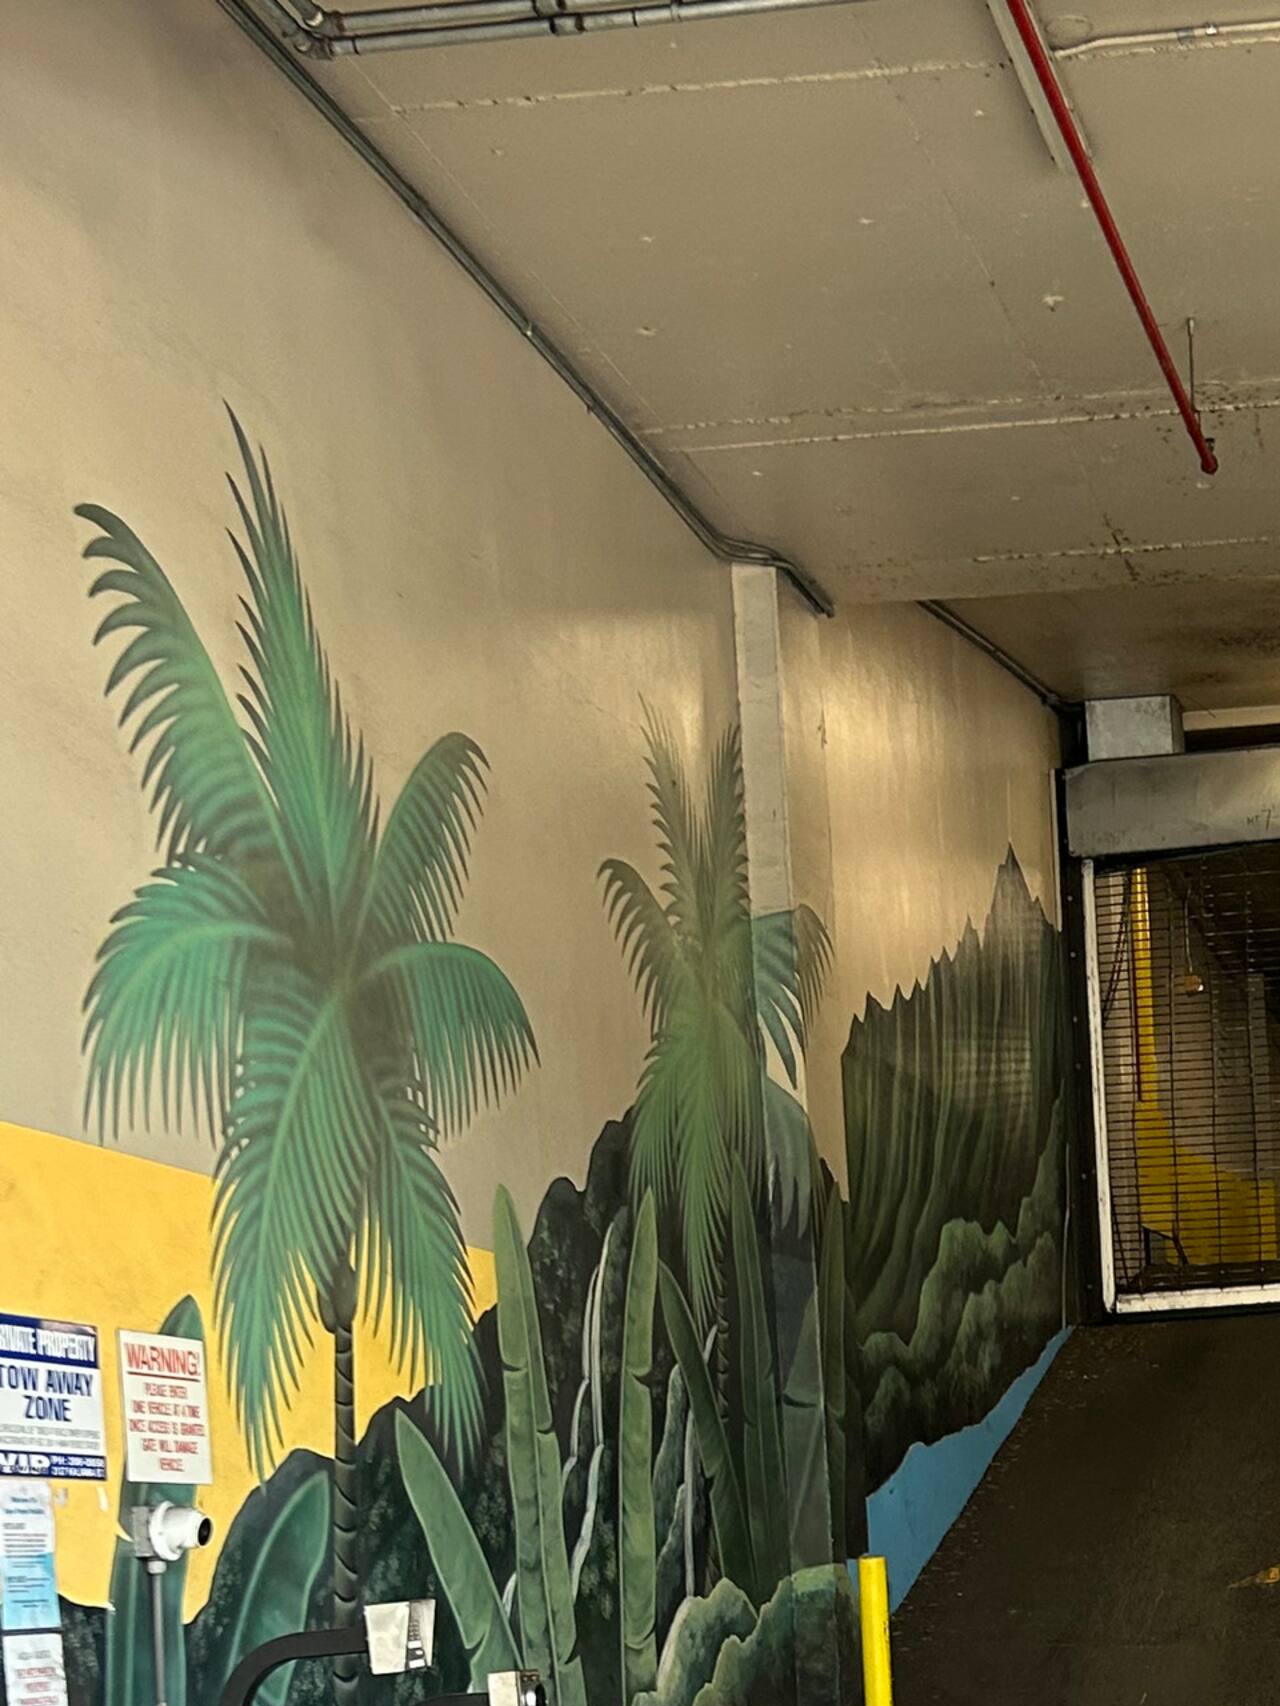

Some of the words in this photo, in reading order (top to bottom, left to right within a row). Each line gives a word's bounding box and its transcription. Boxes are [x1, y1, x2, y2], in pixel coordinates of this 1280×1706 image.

[0, 1323, 37, 1354] RIVATE
[36, 1328, 96, 1362] PROPERTY
[125, 1343, 200, 1376] WARNING!
[0, 1363, 39, 1391] TOW
[45, 1369, 94, 1397] AWAY
[22, 1394, 72, 1422] ZONE
